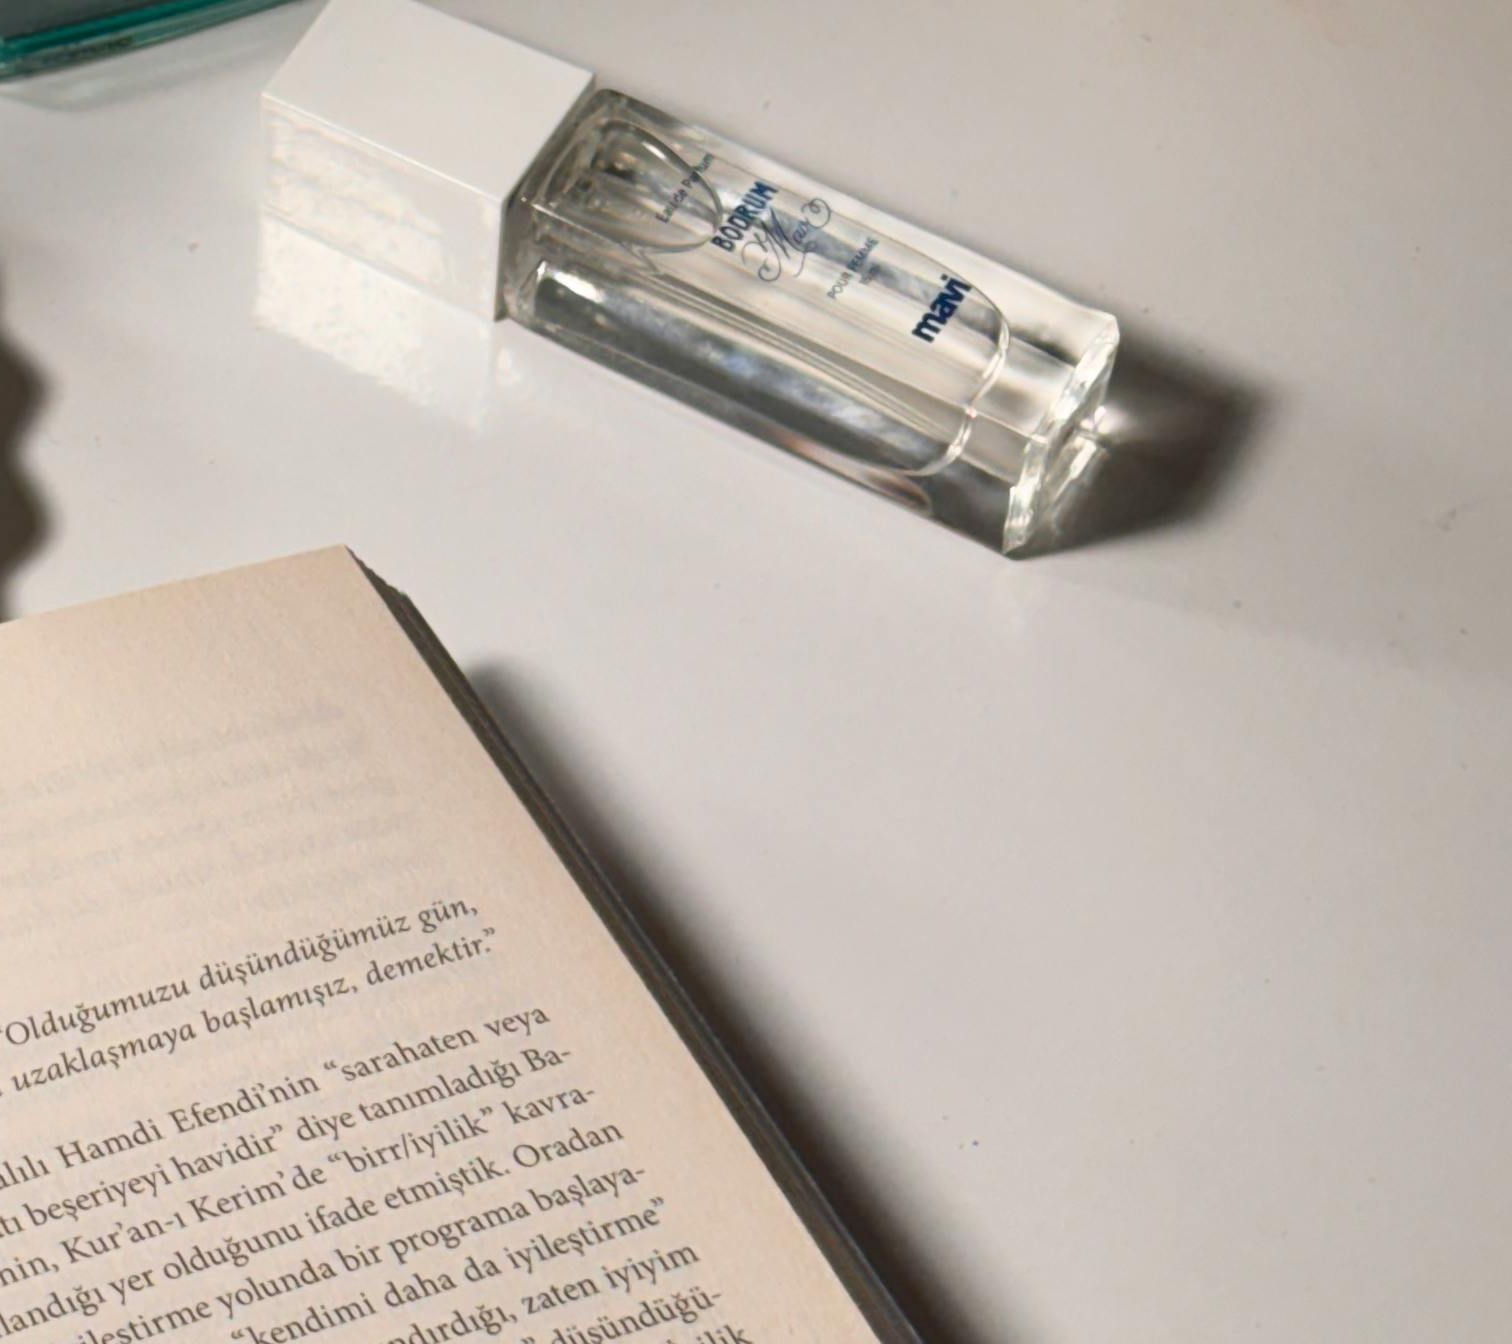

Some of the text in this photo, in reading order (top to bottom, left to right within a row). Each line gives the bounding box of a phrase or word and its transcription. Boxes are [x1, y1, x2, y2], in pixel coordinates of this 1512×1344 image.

[710, 181, 779, 253] BODRUM
[827, 272, 852, 300] POUR
[847, 236, 880, 274] FEMME
[911, 274, 973, 343] mavi
[199, 914, 412, 991] düşündüğümüz
[417, 899, 479, 934] gün,
[10, 1023, 197, 1092] uzaklaşmaya
[199, 976, 358, 1034] başlamışız,
[53, 1117, 164, 1169] Hamdi
[482, 1008, 551, 1037] veya
[500, 1088, 595, 1125] kavra-
[21, 1162, 173, 1227] beşeriyeyi
[296, 1111, 357, 1142] diye
[357, 1058, 523, 1122] tanımladığı
[383, 1272, 458, 1308] daha
[463, 1255, 503, 1283] da
